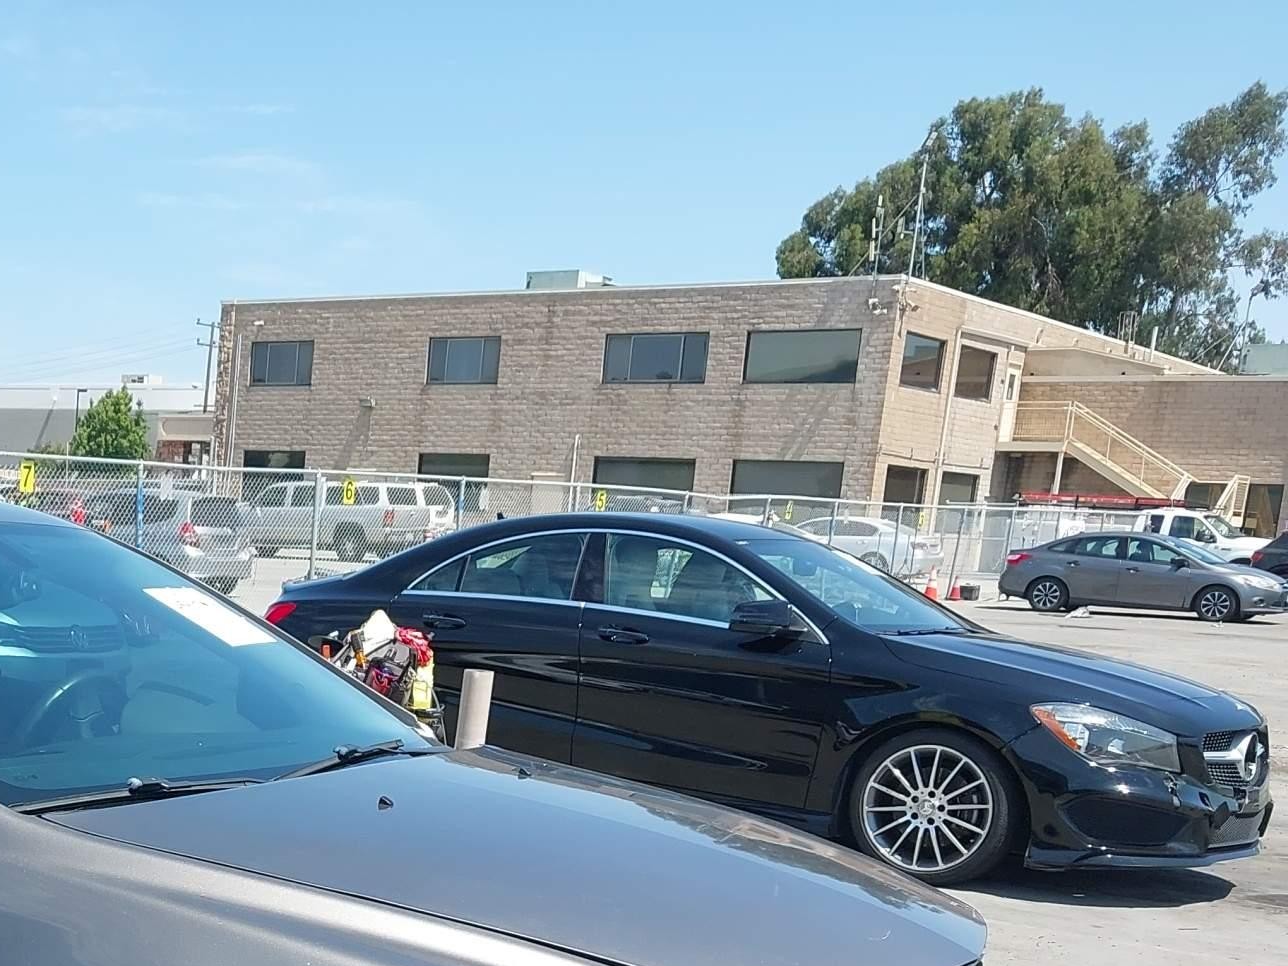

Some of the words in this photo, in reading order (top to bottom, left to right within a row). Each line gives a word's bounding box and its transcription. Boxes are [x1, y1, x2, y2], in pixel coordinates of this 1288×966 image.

[23, 465, 32, 487] 7
[345, 481, 353, 500] 6
[598, 492, 604, 509] 5
